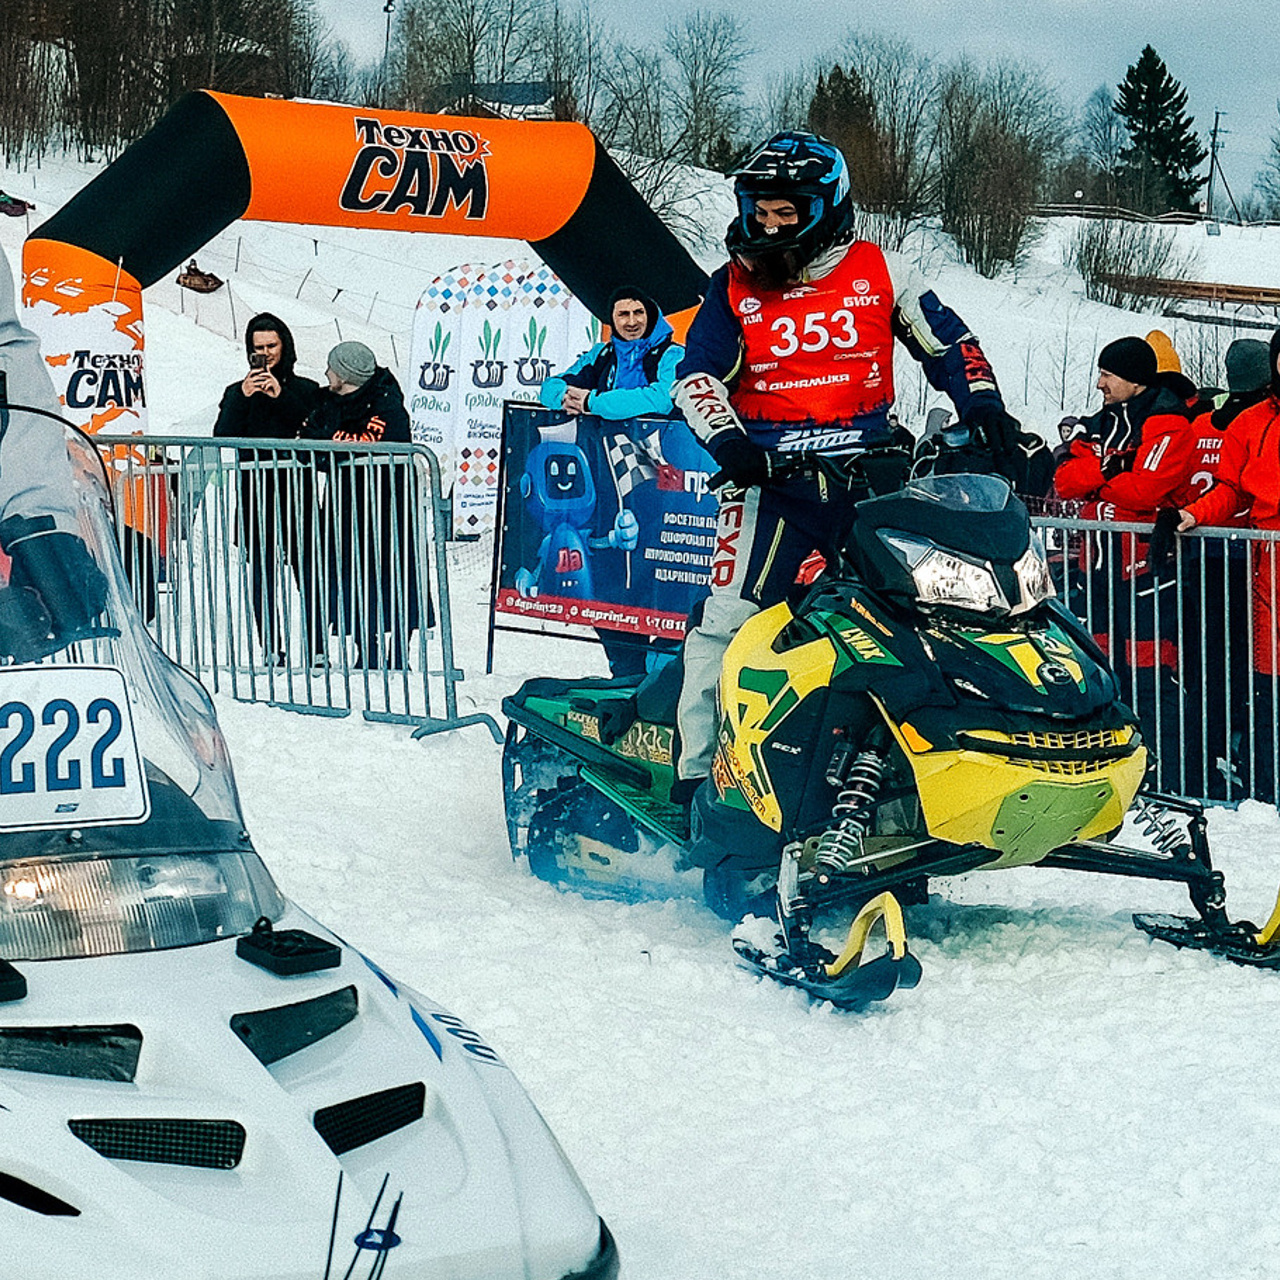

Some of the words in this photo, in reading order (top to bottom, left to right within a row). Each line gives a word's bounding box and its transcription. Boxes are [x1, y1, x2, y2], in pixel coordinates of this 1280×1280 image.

[339, 146, 489, 220] САМ
[770, 308, 859, 358] 353
[66, 369, 147, 409] САМ
